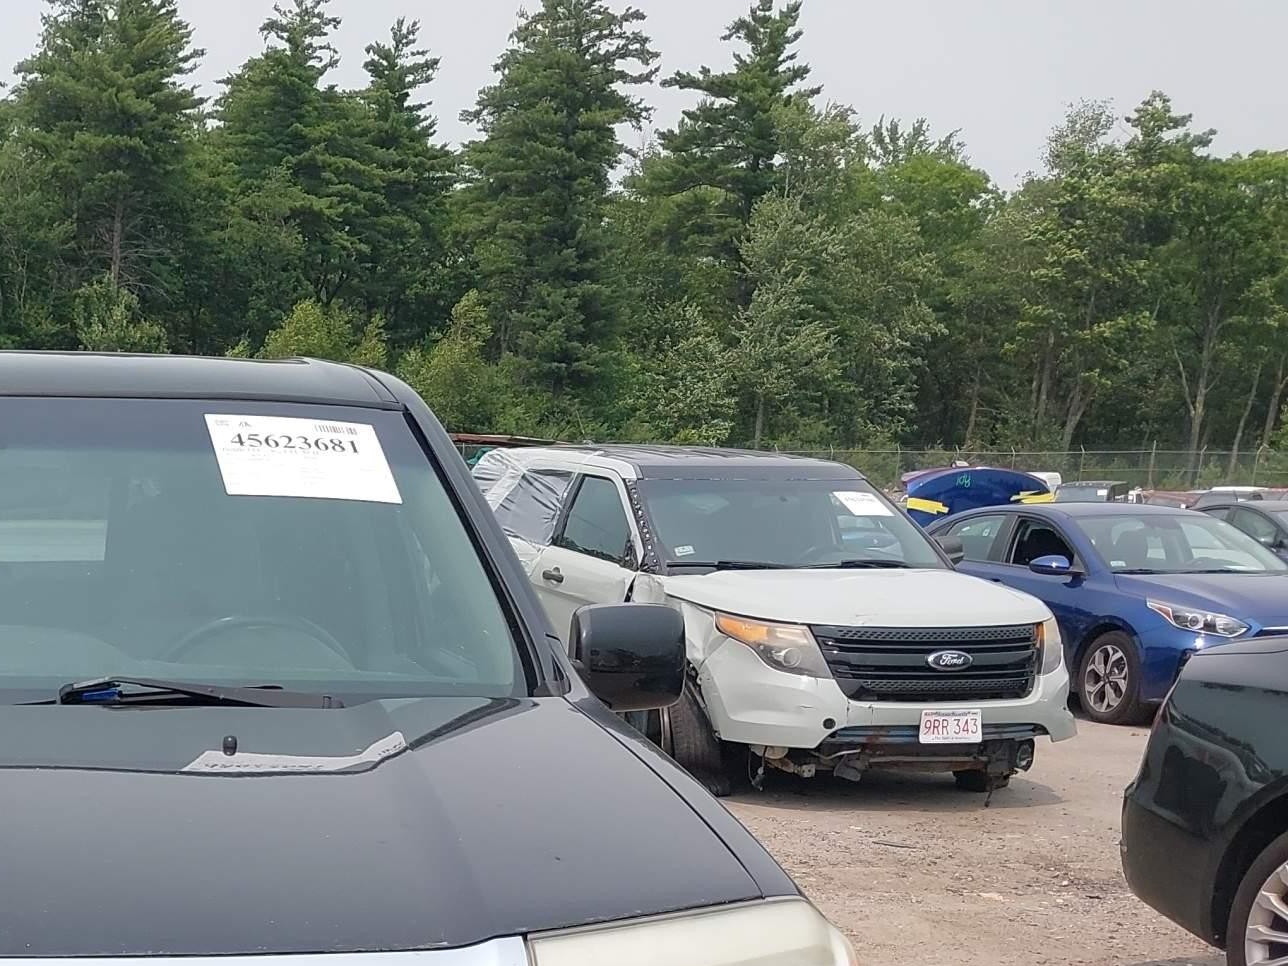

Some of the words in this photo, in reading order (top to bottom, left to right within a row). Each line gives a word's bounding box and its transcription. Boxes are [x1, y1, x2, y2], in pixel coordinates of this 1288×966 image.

[230, 432, 360, 454] 45623681
[939, 653, 965, 666] Ford
[923, 719, 949, 735] 9RR
[953, 718, 978, 735] 343
